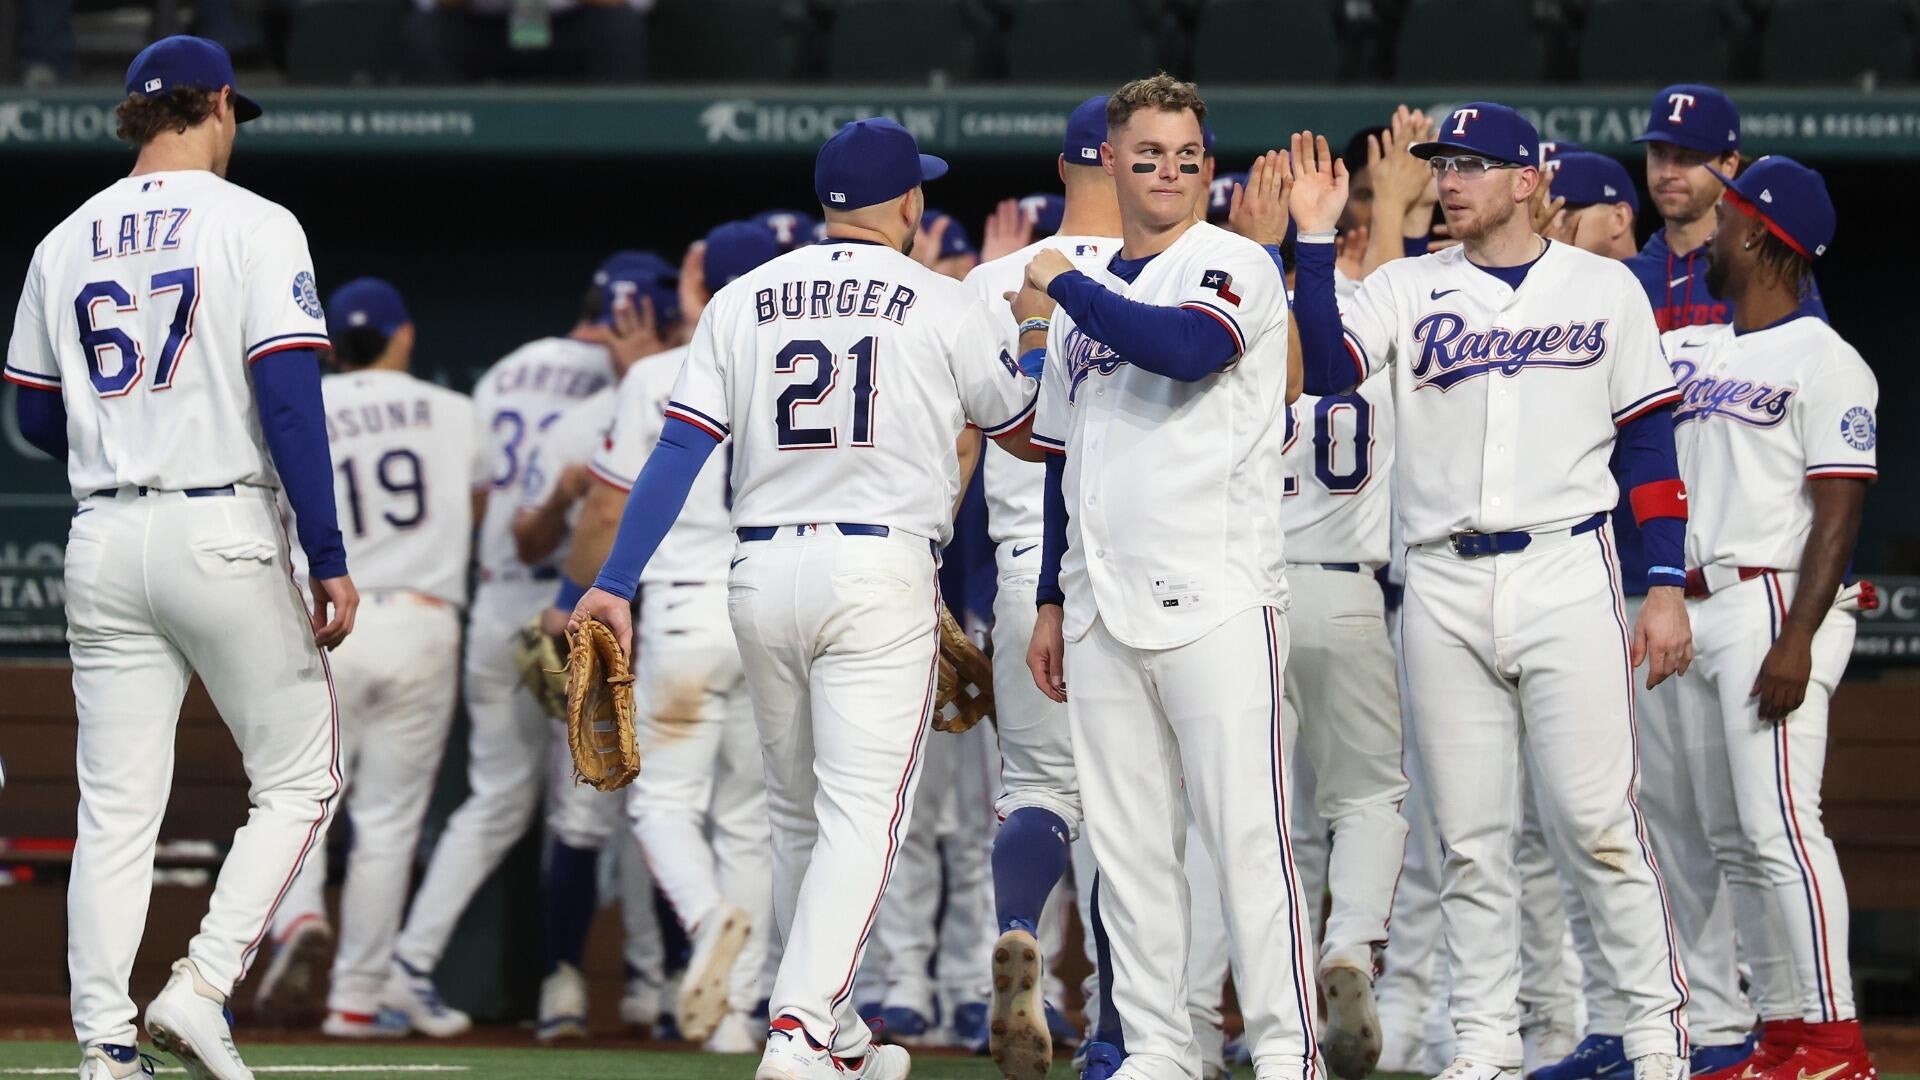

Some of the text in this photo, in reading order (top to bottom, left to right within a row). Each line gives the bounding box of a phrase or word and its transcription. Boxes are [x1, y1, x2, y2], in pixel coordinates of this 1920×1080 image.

[1452, 108, 1479, 138] T
[1667, 93, 1695, 124] T
[1823, 112, 1920, 137] RESORT
[91, 207, 191, 262] LATZ
[755, 278, 918, 327] BURGER
[74, 266, 201, 399] 67
[1409, 310, 1611, 394] Rangers
[774, 335, 880, 451] 21
[338, 448, 427, 538] 19
